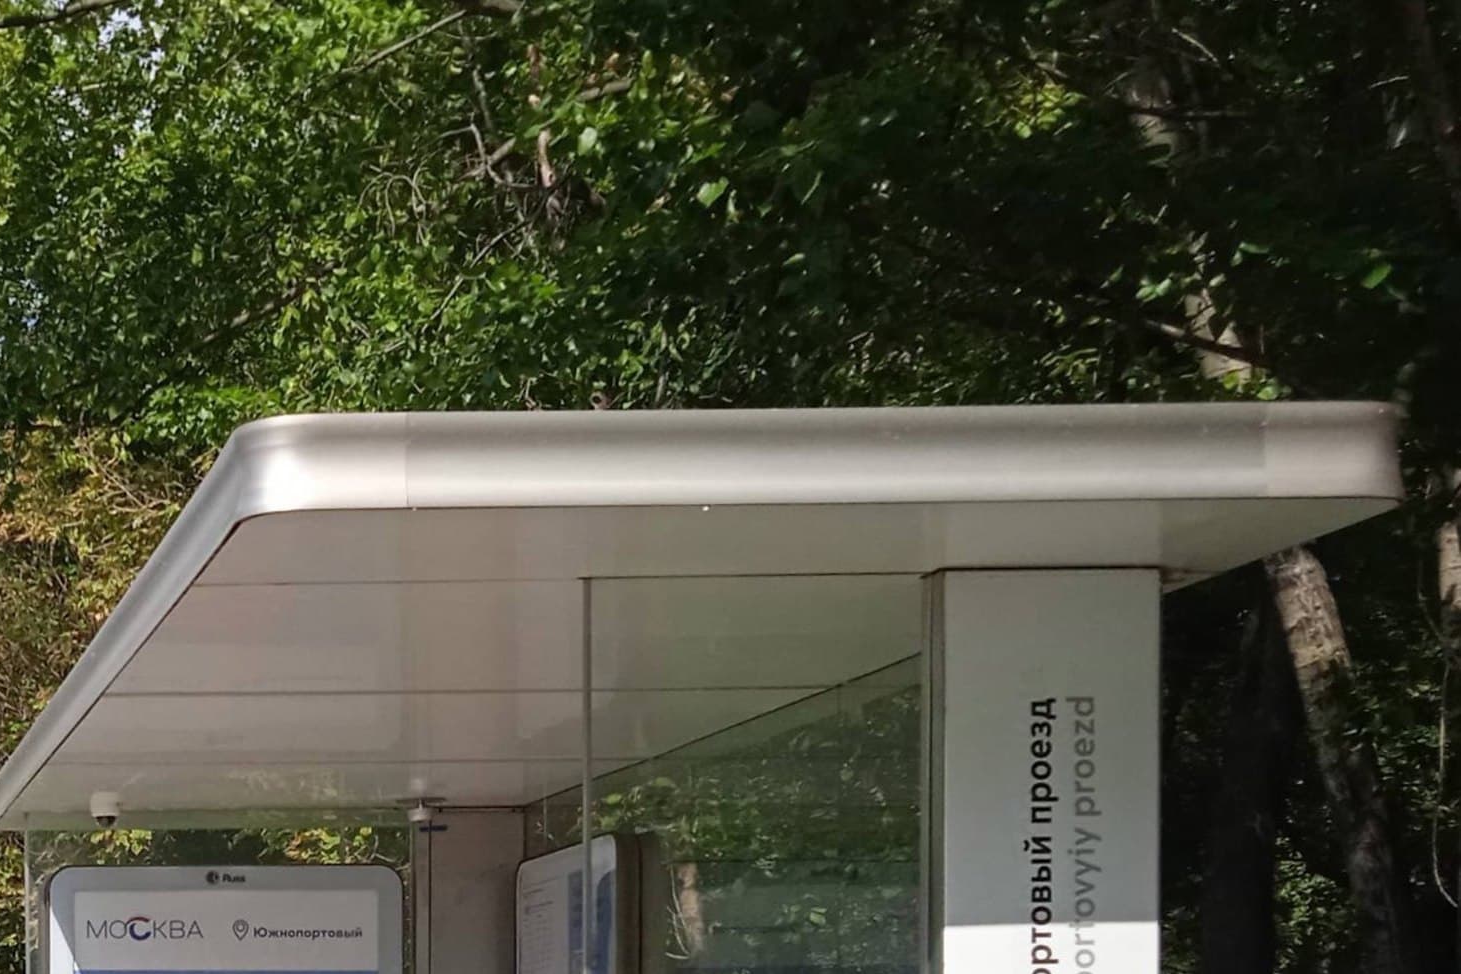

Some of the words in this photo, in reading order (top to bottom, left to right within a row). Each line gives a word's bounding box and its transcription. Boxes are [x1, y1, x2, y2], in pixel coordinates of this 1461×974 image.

[1029, 696, 1059, 824] проезд
[1065, 696, 1102, 816] proezd
[86, 917, 204, 941] МОСКВА
[253, 926, 363, 940] Южнопортовый
